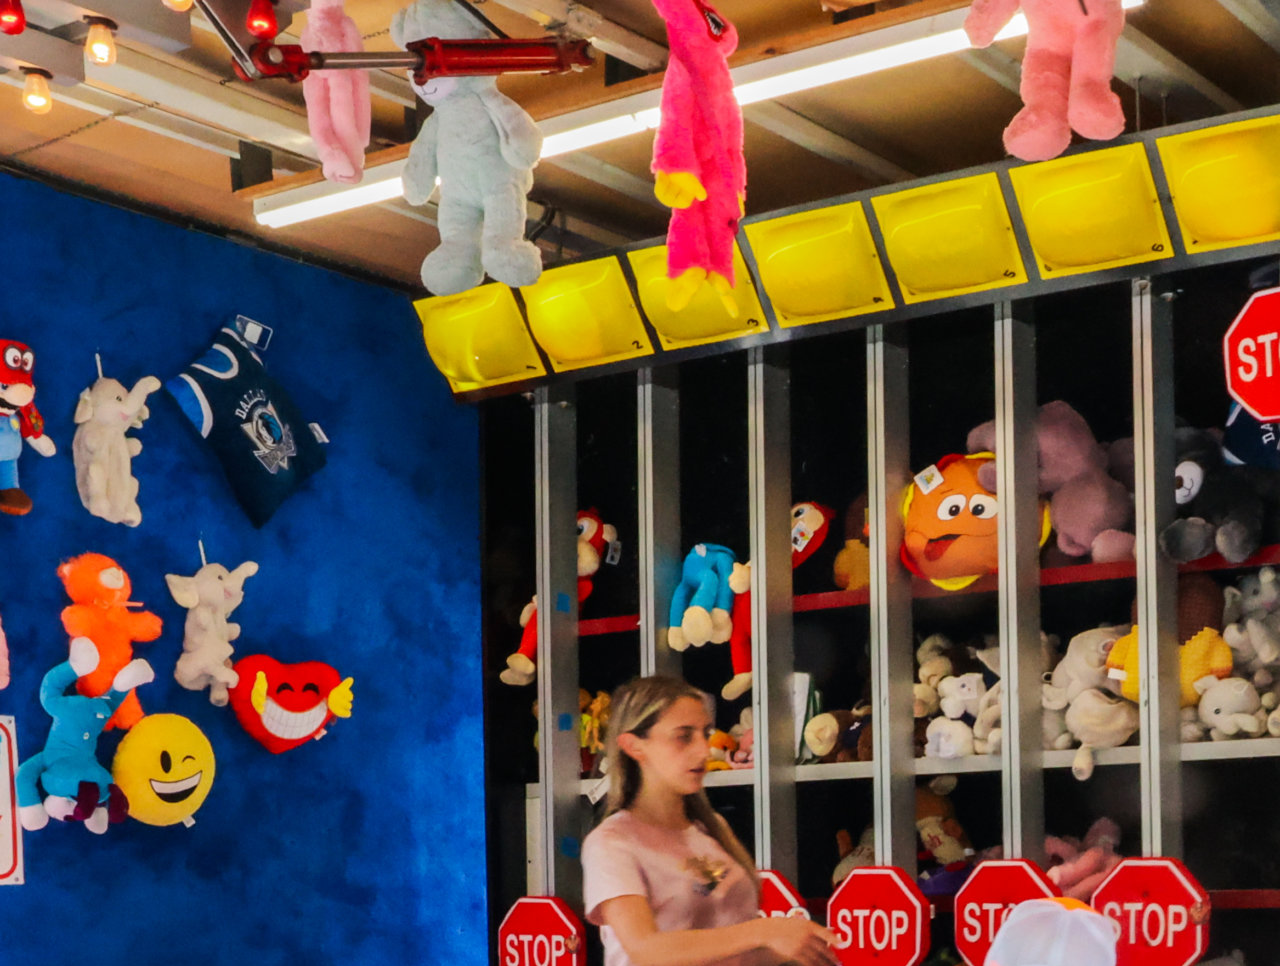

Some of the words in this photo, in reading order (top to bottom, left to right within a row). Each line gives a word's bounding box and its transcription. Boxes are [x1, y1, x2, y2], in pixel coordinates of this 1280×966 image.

[631, 339, 644, 350] 2
[837, 907, 909, 951] STOP
[962, 901, 1017, 943] ST
[1102, 901, 1188, 948] STOP
